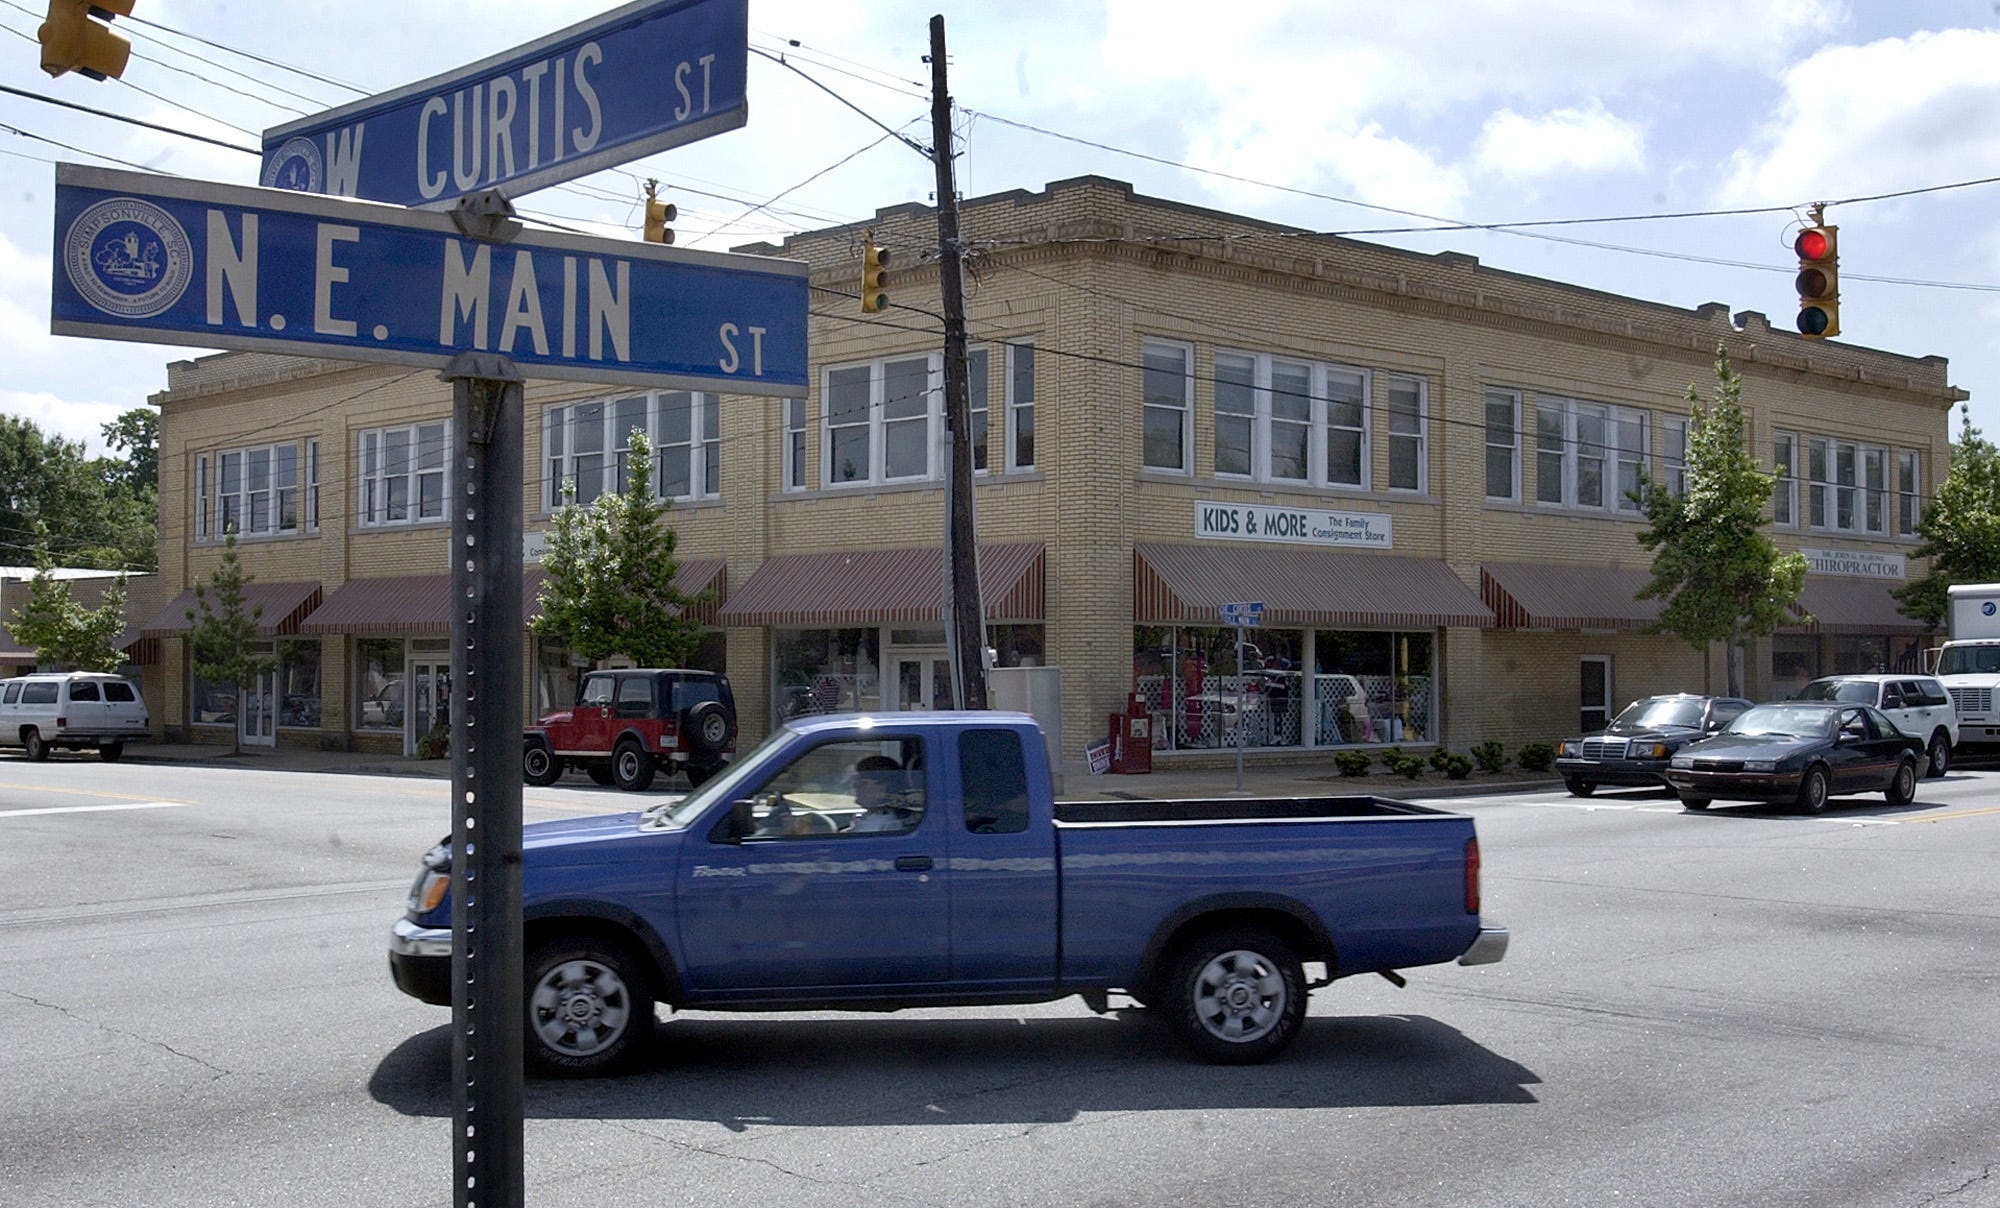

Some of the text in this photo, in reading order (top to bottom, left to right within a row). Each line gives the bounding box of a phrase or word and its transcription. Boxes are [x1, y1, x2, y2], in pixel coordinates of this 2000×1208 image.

[326, 122, 365, 197] W
[417, 42, 603, 199] CURTIS
[674, 53, 716, 121] ST
[439, 238, 631, 362] MAIN
[719, 322, 767, 377] ST
[1203, 507, 1308, 538] KIDS & MORE
[1312, 527, 1385, 541] Consignment Store
[1328, 516, 1370, 530] The Family
[1807, 558, 1899, 577] CHIROPRACTOR
